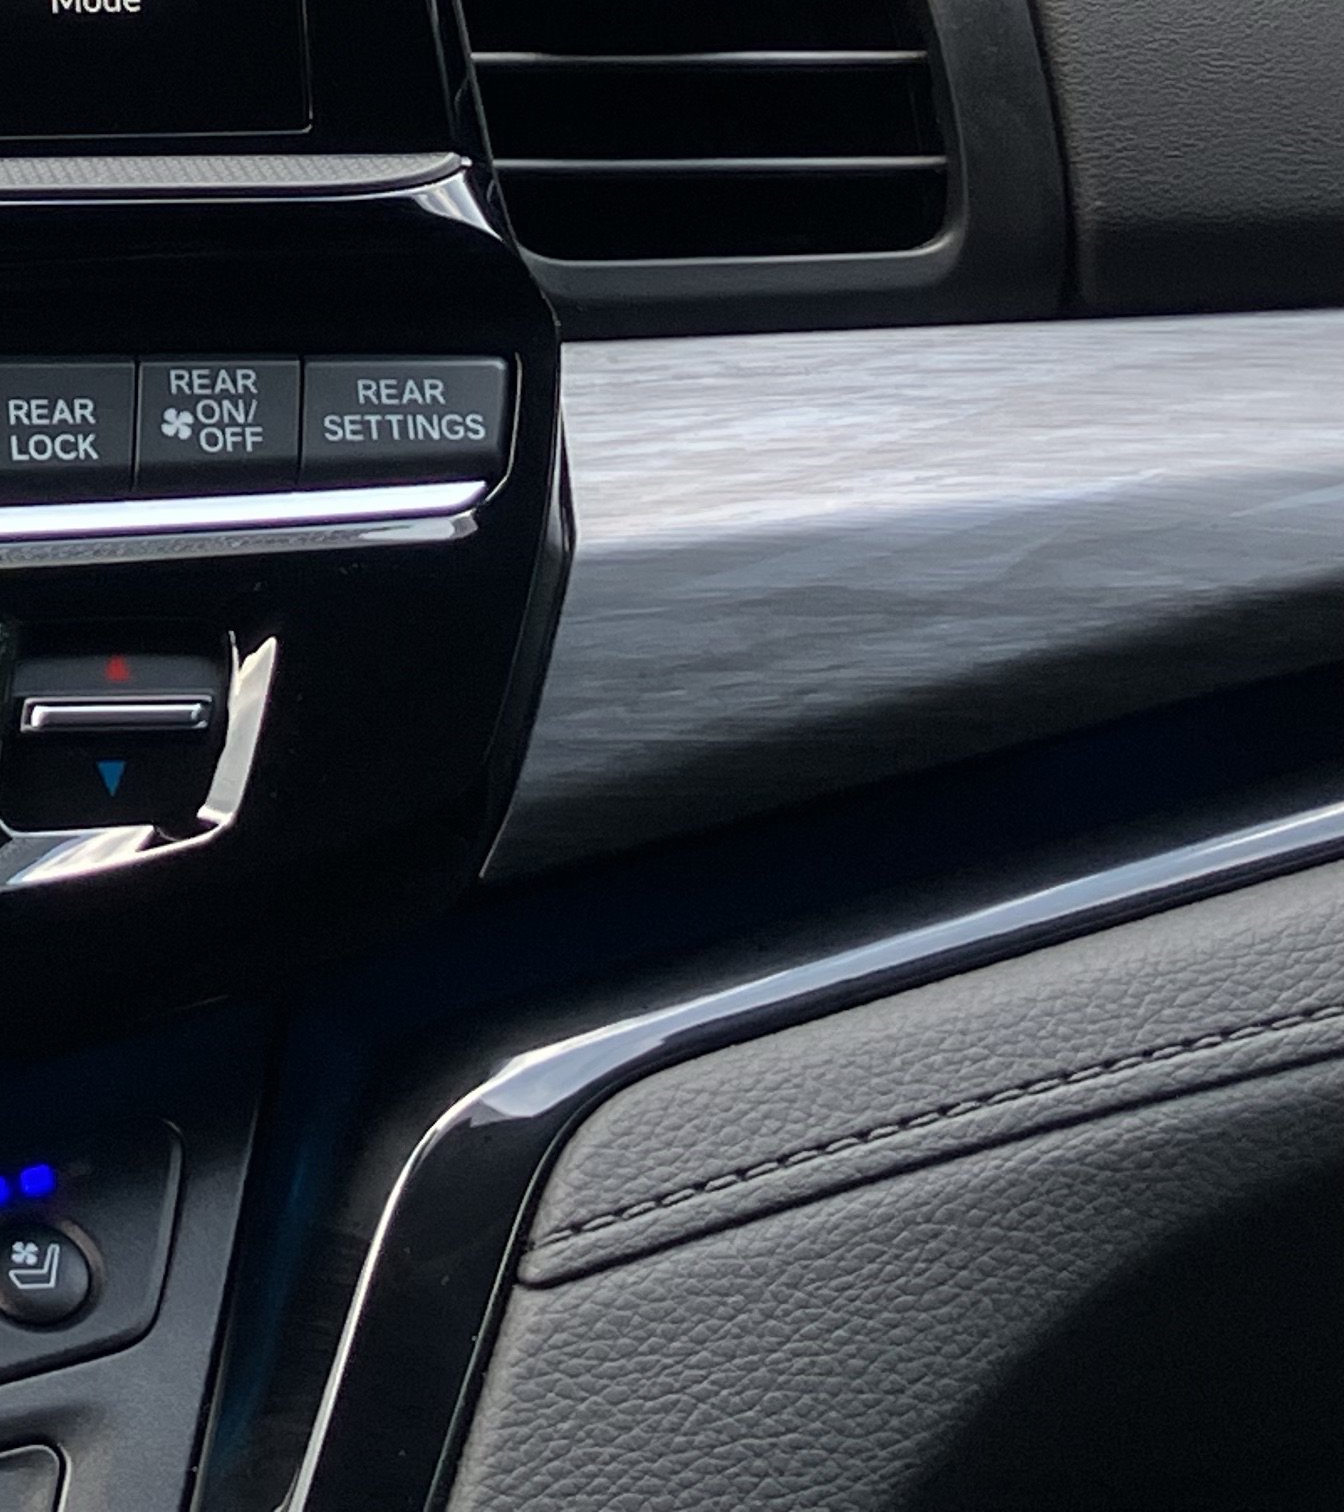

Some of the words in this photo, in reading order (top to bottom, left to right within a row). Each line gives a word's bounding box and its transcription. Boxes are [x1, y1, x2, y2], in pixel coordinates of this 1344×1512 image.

[169, 368, 258, 395] REAR
[357, 378, 446, 405] REAR
[8, 398, 96, 426] REAR
[196, 399, 258, 425] ON/
[199, 426, 263, 453] OFF
[324, 413, 486, 441] SETTINGS
[10, 433, 99, 461] LOCK
